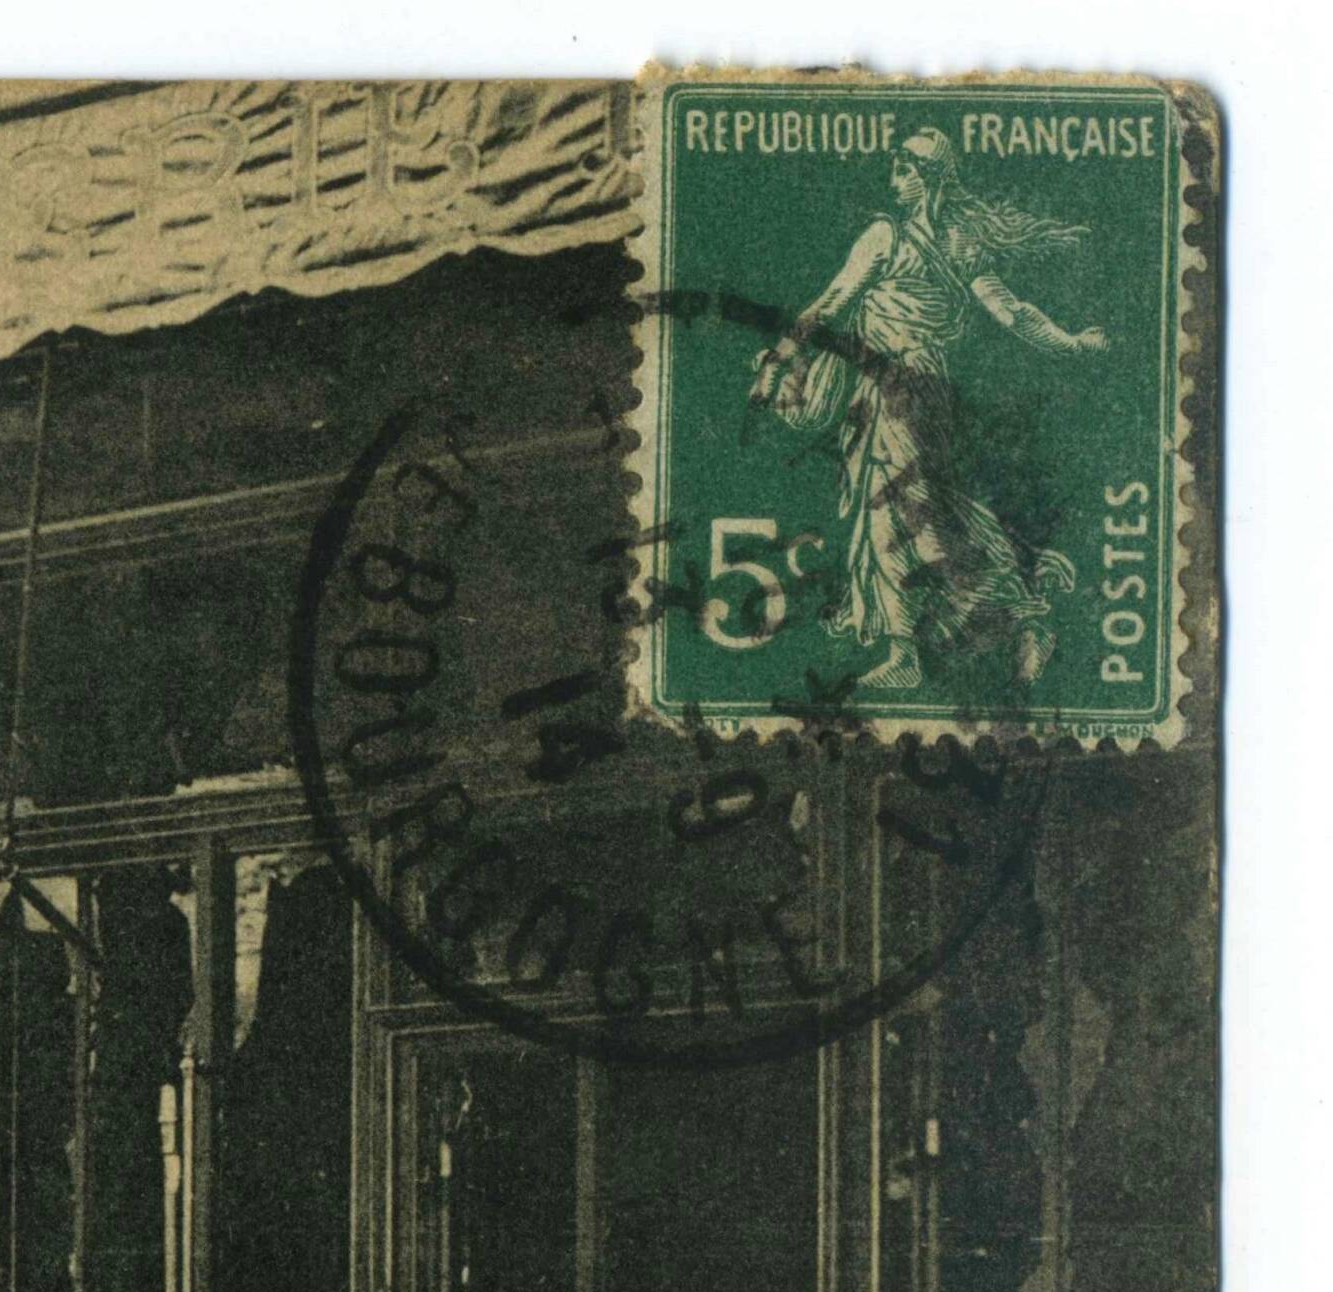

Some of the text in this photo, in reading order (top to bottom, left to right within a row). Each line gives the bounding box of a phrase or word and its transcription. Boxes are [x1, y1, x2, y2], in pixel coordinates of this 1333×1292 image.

[686, 110, 895, 159] REPUBLIQUE
[963, 115, 1155, 160] FRANÇAISE
[1100, 481, 1149, 684] POSTES
